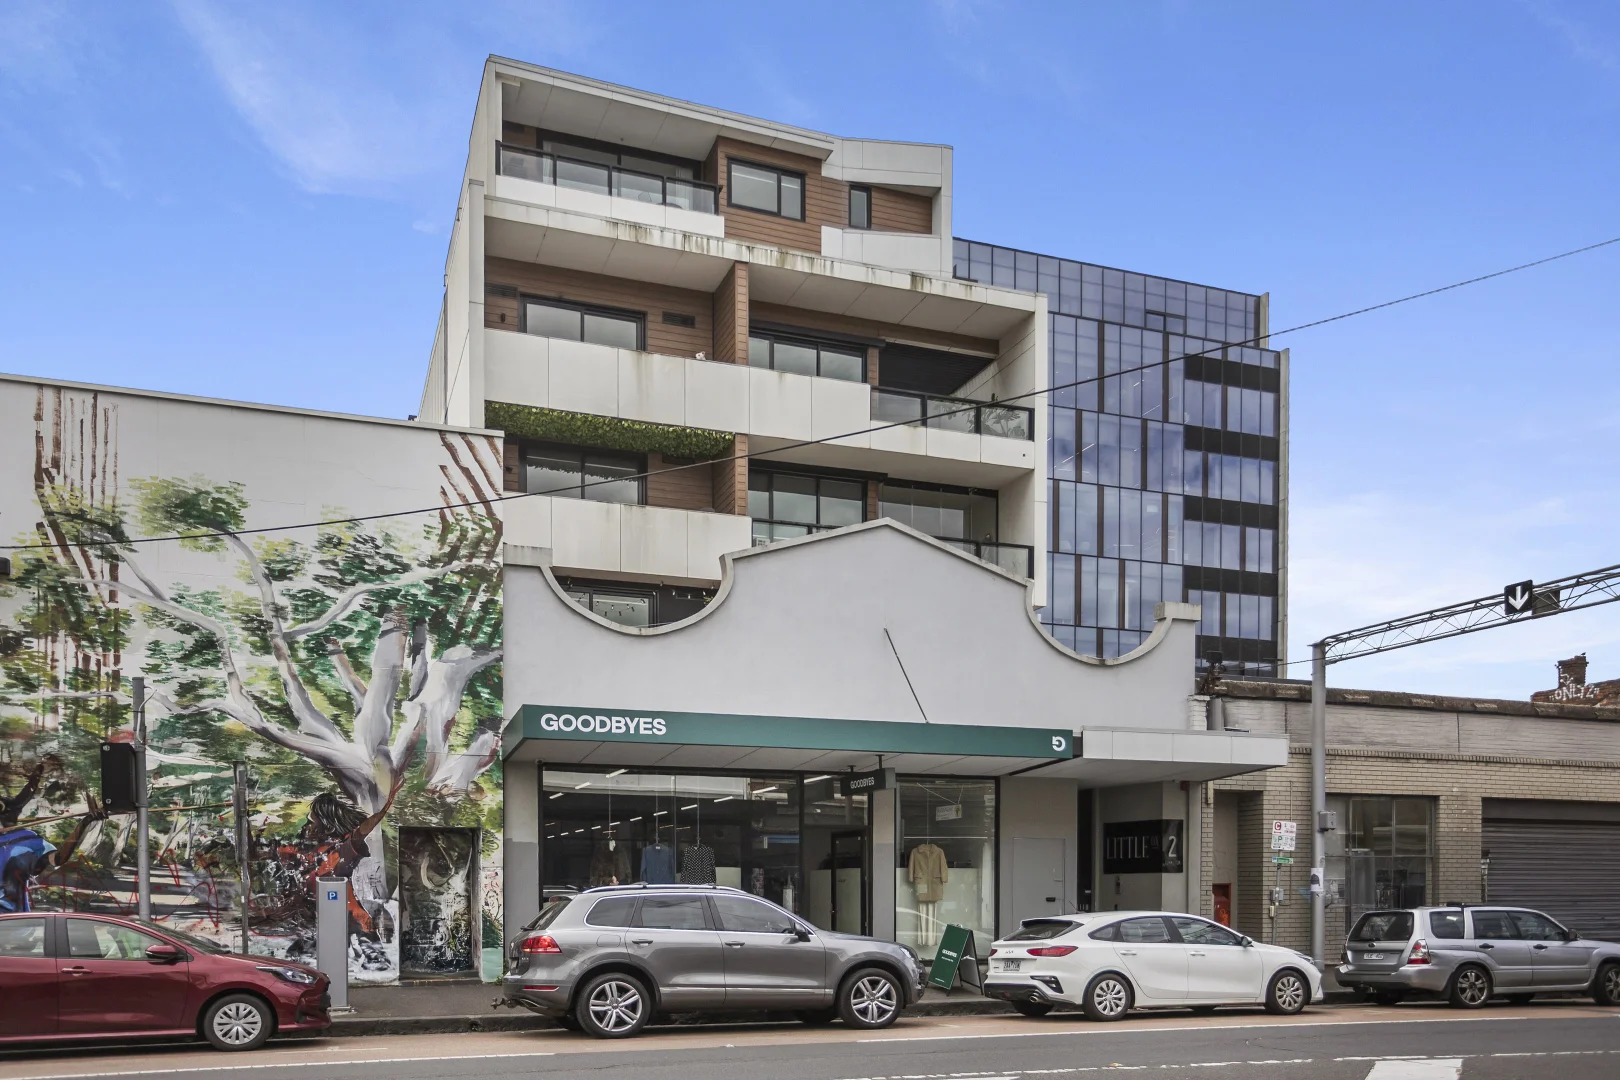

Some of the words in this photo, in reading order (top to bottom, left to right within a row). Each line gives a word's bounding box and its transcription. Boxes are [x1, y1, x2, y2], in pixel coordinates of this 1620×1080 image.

[540, 713, 667, 736] GOODBYES
[850, 777, 875, 789] GOODBYES
[1106, 836, 1149, 859] LITTLE
[1168, 835, 1177, 857] 2
